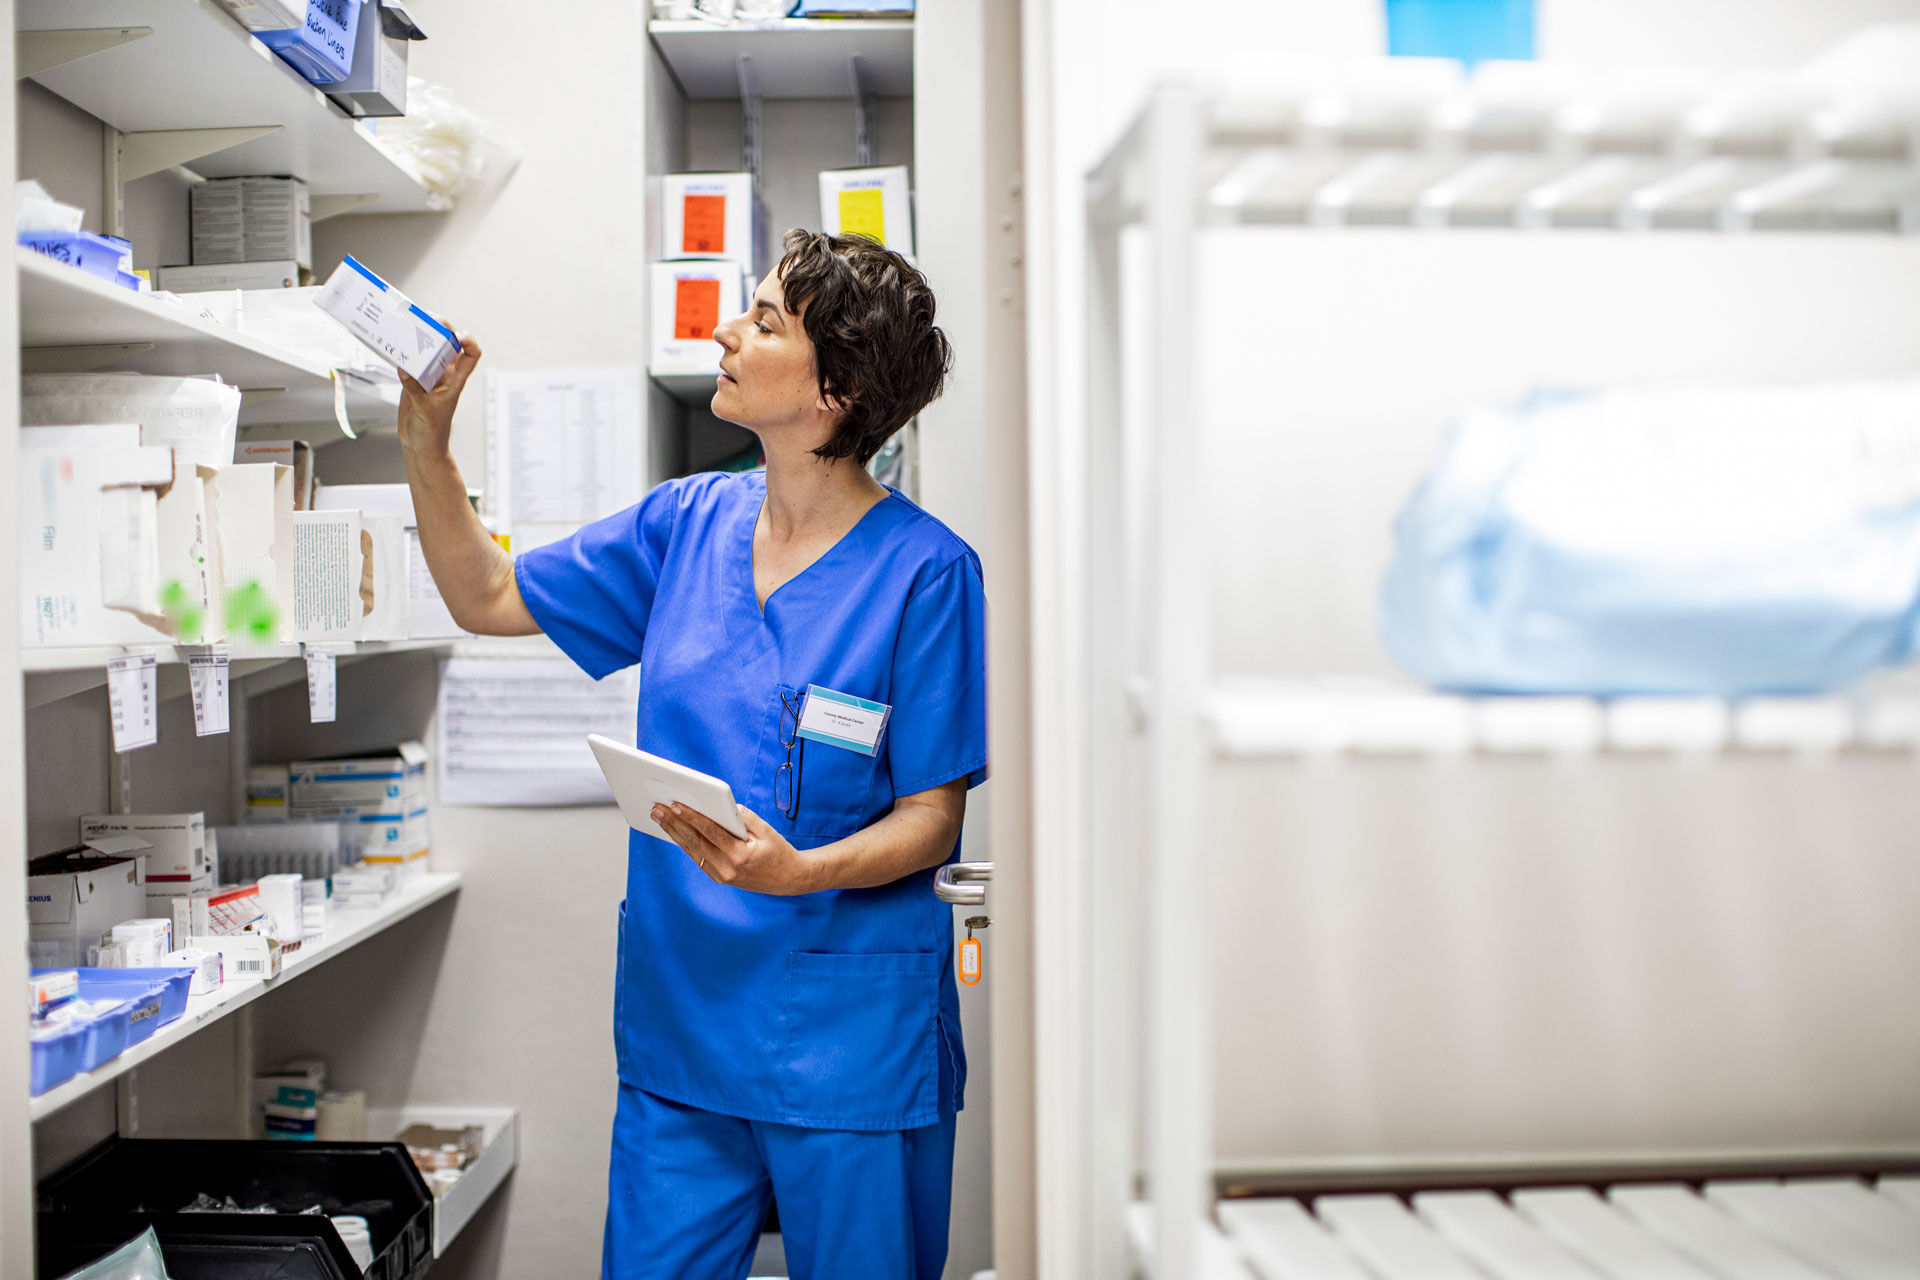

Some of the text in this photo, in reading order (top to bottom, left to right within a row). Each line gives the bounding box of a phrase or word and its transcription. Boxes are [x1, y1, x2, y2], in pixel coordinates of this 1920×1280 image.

[307, 13, 345, 60] Suction Liners
[42, 526, 55, 550] Film
[28, 895, 52, 903] ENIUS
